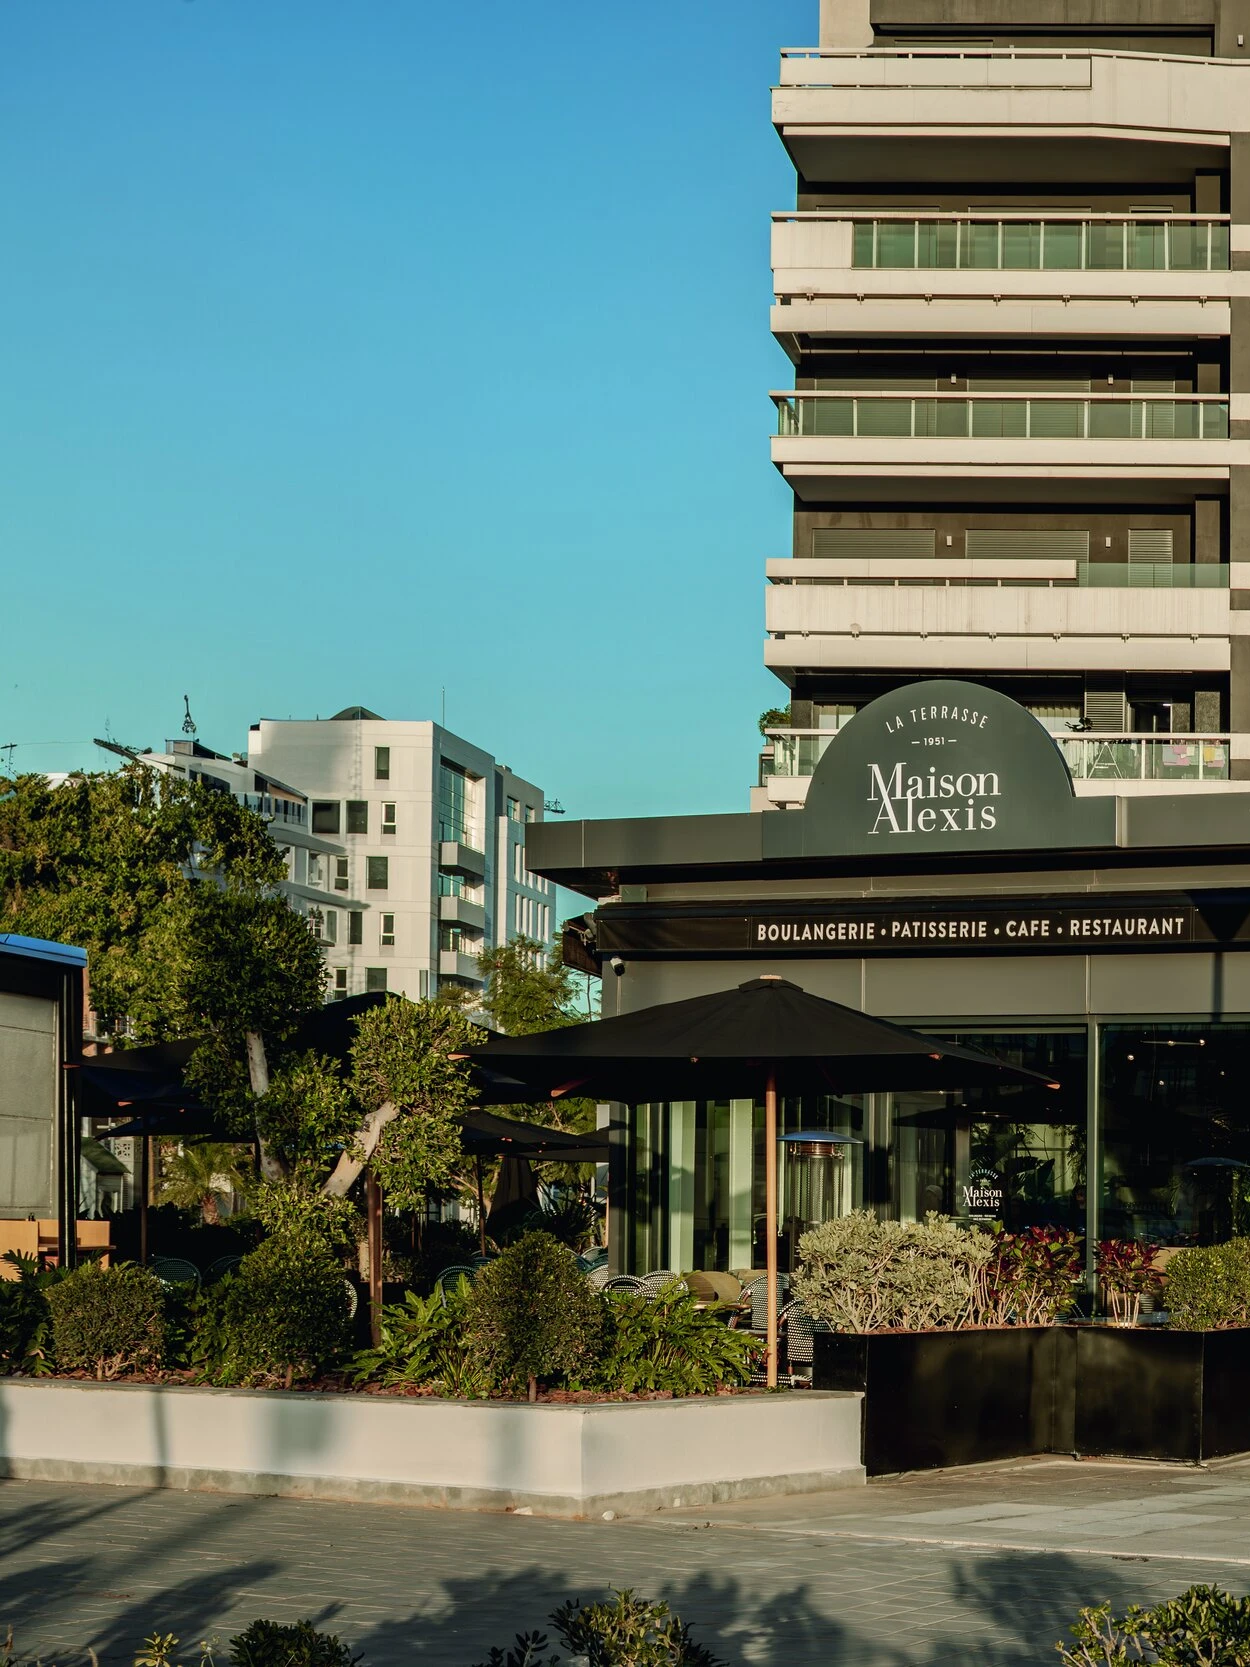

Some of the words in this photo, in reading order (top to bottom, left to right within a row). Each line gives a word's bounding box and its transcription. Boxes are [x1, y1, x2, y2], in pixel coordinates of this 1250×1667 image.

[885, 715, 904, 733] LA
[910, 705, 988, 728] TERRASSE
[923, 736, 945, 746] 1951
[866, 762, 1001, 801] Maison
[867, 798, 997, 834] Alexis
[757, 922, 875, 941] BOULANGERIE
[891, 920, 987, 938] PATISSERIE
[1005, 919, 1050, 937] CAFE
[1070, 917, 1184, 936] RESTAURANT
[962, 1185, 1003, 1198] Maison
[962, 1196, 1000, 1207] Alexis
